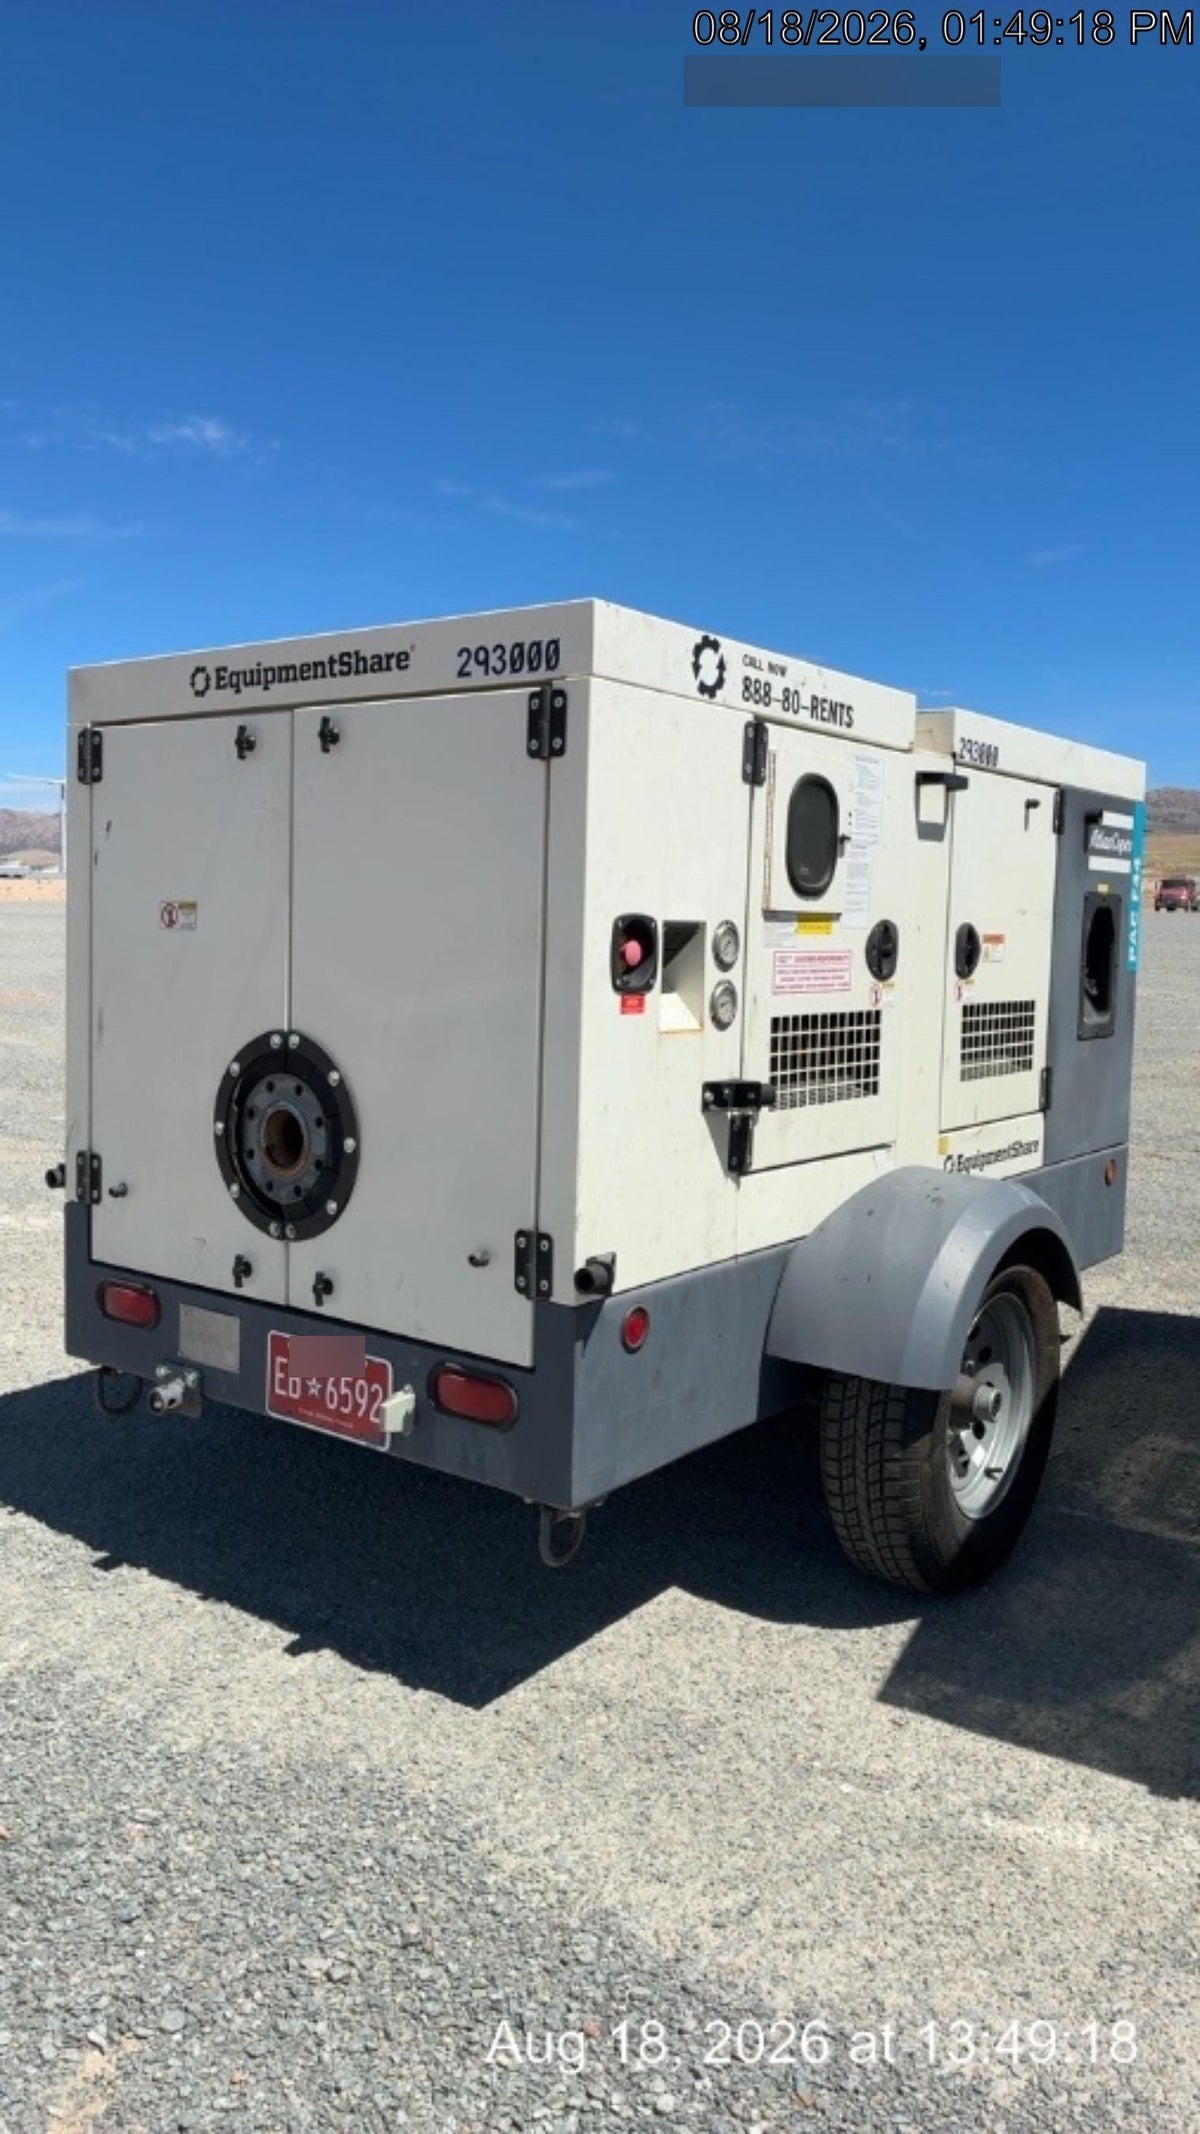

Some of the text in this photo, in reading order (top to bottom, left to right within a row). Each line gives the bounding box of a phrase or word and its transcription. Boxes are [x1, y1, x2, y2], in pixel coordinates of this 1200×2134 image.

[214, 648, 410, 695] EquipmentShare
[456, 637, 561, 678] 293000
[741, 675, 855, 729] 888-80-RENTS
[959, 736, 1000, 767] 293000
[325, 1376, 385, 1424] 6592
